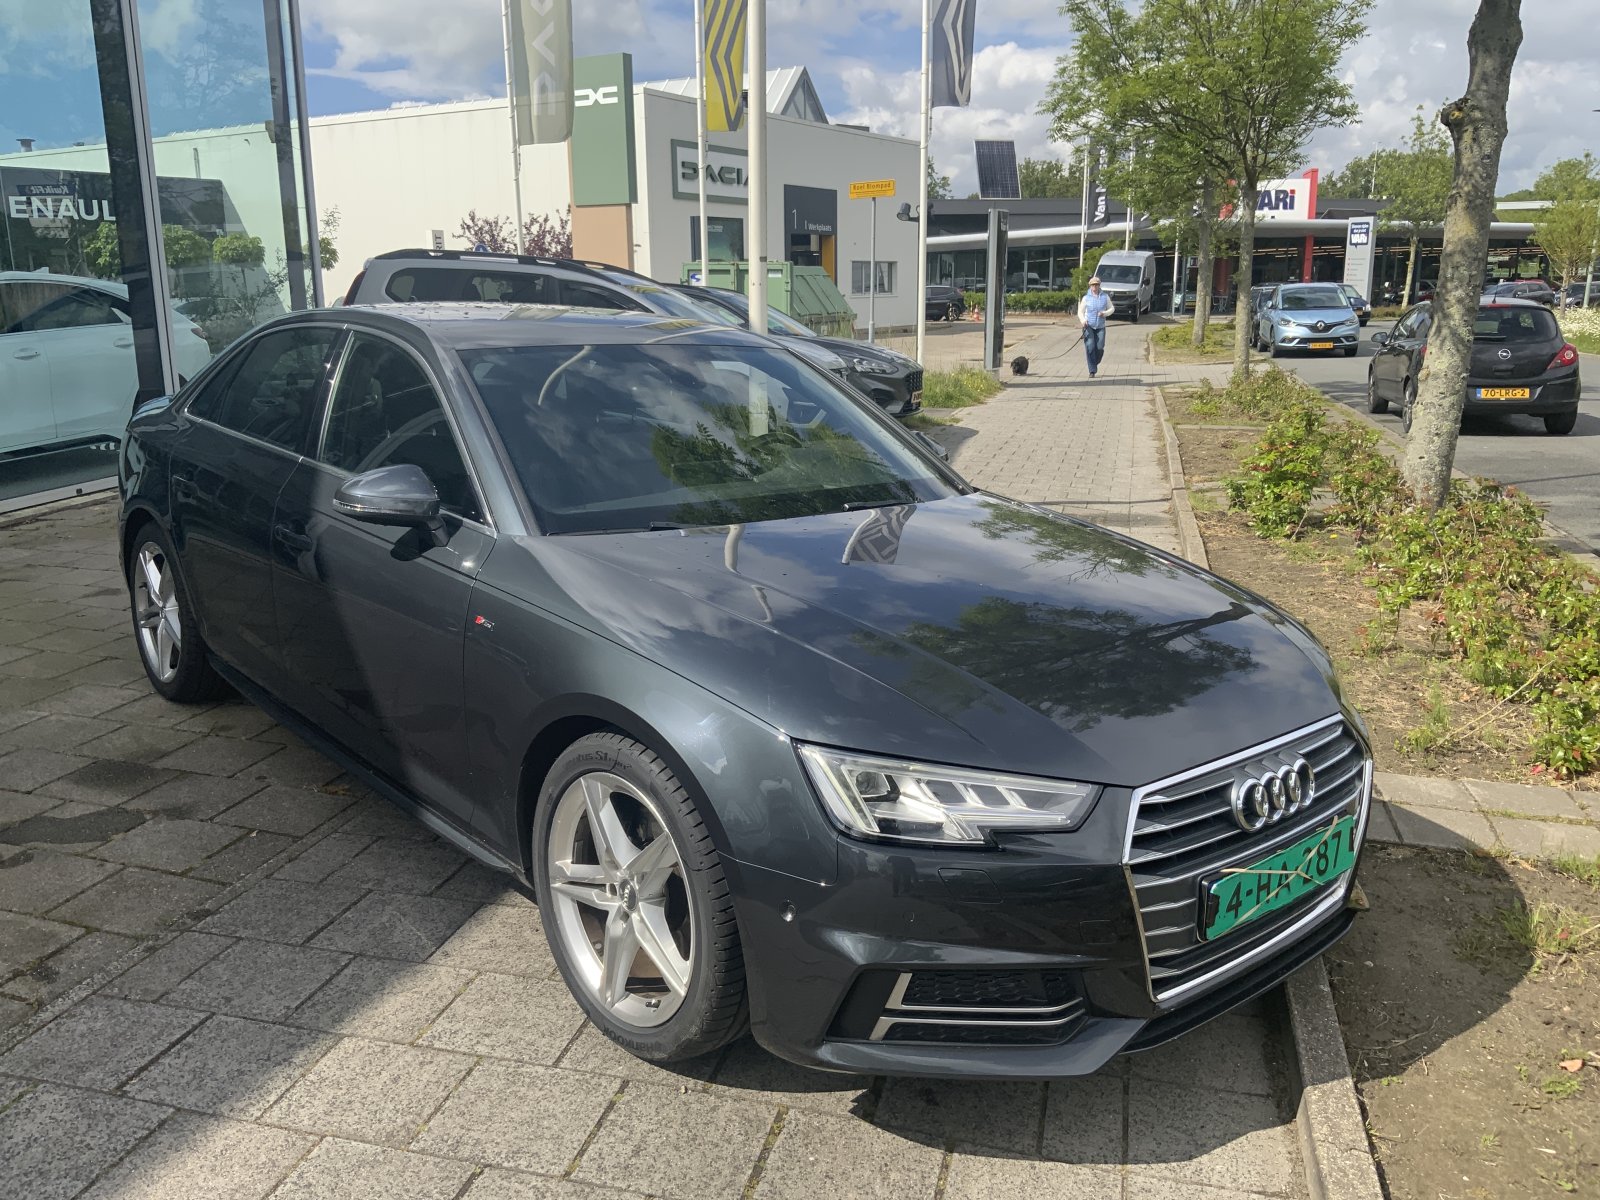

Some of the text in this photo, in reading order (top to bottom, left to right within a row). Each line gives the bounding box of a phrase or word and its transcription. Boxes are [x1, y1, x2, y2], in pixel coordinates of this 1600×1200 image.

[681, 161, 748, 186] DACI
[1094, 195, 1107, 222] Van
[1484, 389, 1526, 397] 70-LRG-2
